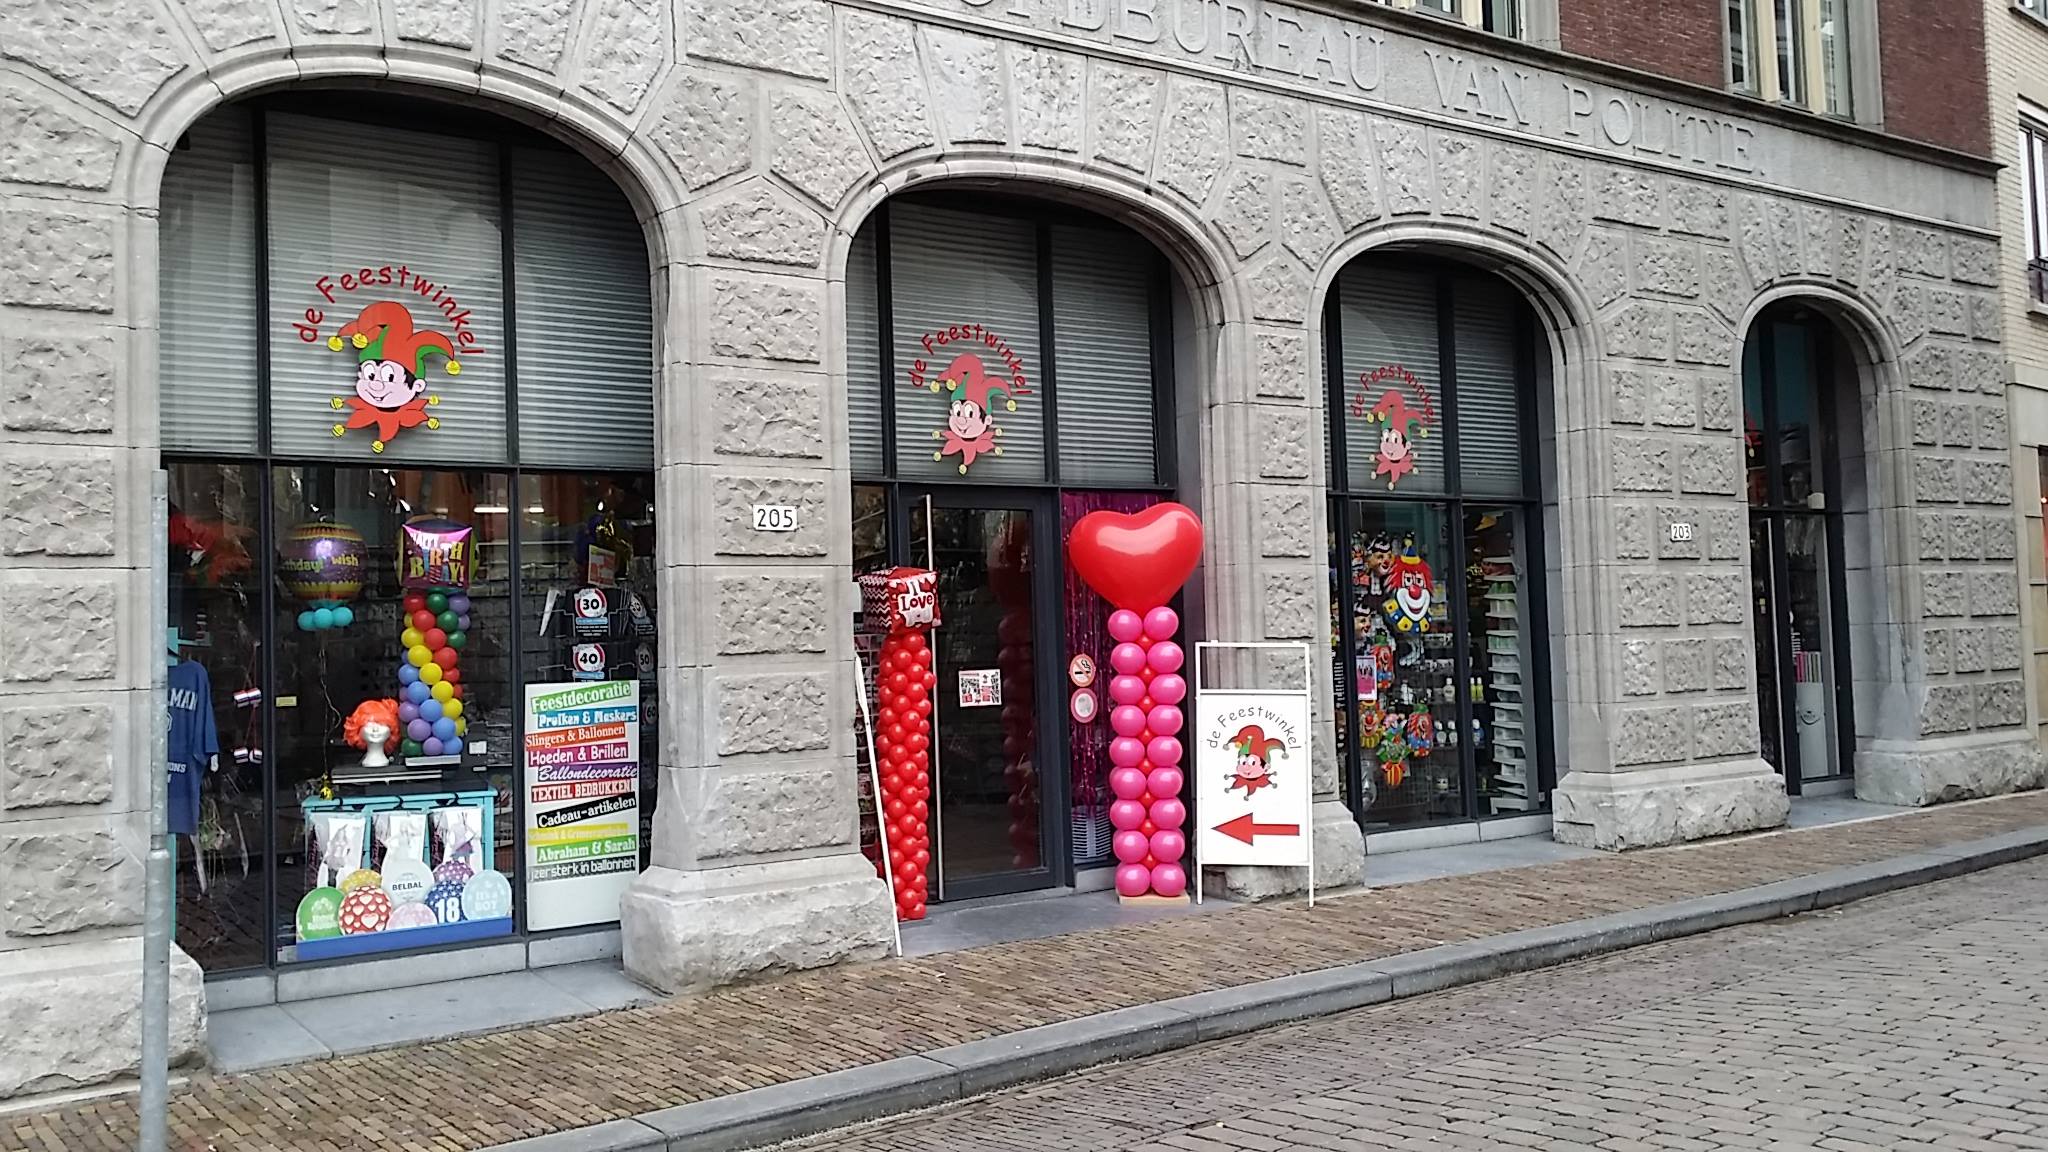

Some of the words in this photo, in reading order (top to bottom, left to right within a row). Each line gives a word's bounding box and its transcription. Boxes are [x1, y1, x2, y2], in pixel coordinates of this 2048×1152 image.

[1424, 48, 1530, 126] VAN
[292, 308, 323, 343] de
[316, 265, 485, 354] Feestwinkel
[908, 359, 927, 387] de
[921, 323, 1033, 395] Feestwinkel
[1350, 393, 1364, 417] de
[1360, 364, 1434, 423] Feestwinkel
[757, 508, 793, 527] 205
[1673, 525, 1690, 539] 203
[582, 598, 600, 610] 30
[900, 594, 933, 611] Love
[580, 653, 598, 664] 40
[531, 681, 631, 714] Feestdecoratie
[539, 712, 580, 727] Pruiken
[582, 710, 591, 724] &
[594, 709, 637, 723] Maskers
[1206, 731, 1221, 748] de
[1217, 706, 1302, 749] Feestwinkel
[526, 733, 565, 748] Slingers
[567, 730, 576, 741] &
[578, 725, 625, 739] Ballonnen
[530, 749, 573, 766] Hoeden
[577, 747, 586, 761] &
[590, 743, 627, 760] Brillen
[538, 764, 638, 780] Ballondecoratie
[532, 784, 573, 801] TEXTIEL
[538, 797, 636, 828] Cadeau-artikelen
[538, 846, 589, 862] Abraham
[592, 841, 601, 855] &
[604, 837, 636, 853] Sarah
[590, 857, 636, 872] ballonnen
[392, 881, 424, 891] BELBAL
[436, 896, 461, 924] 18
